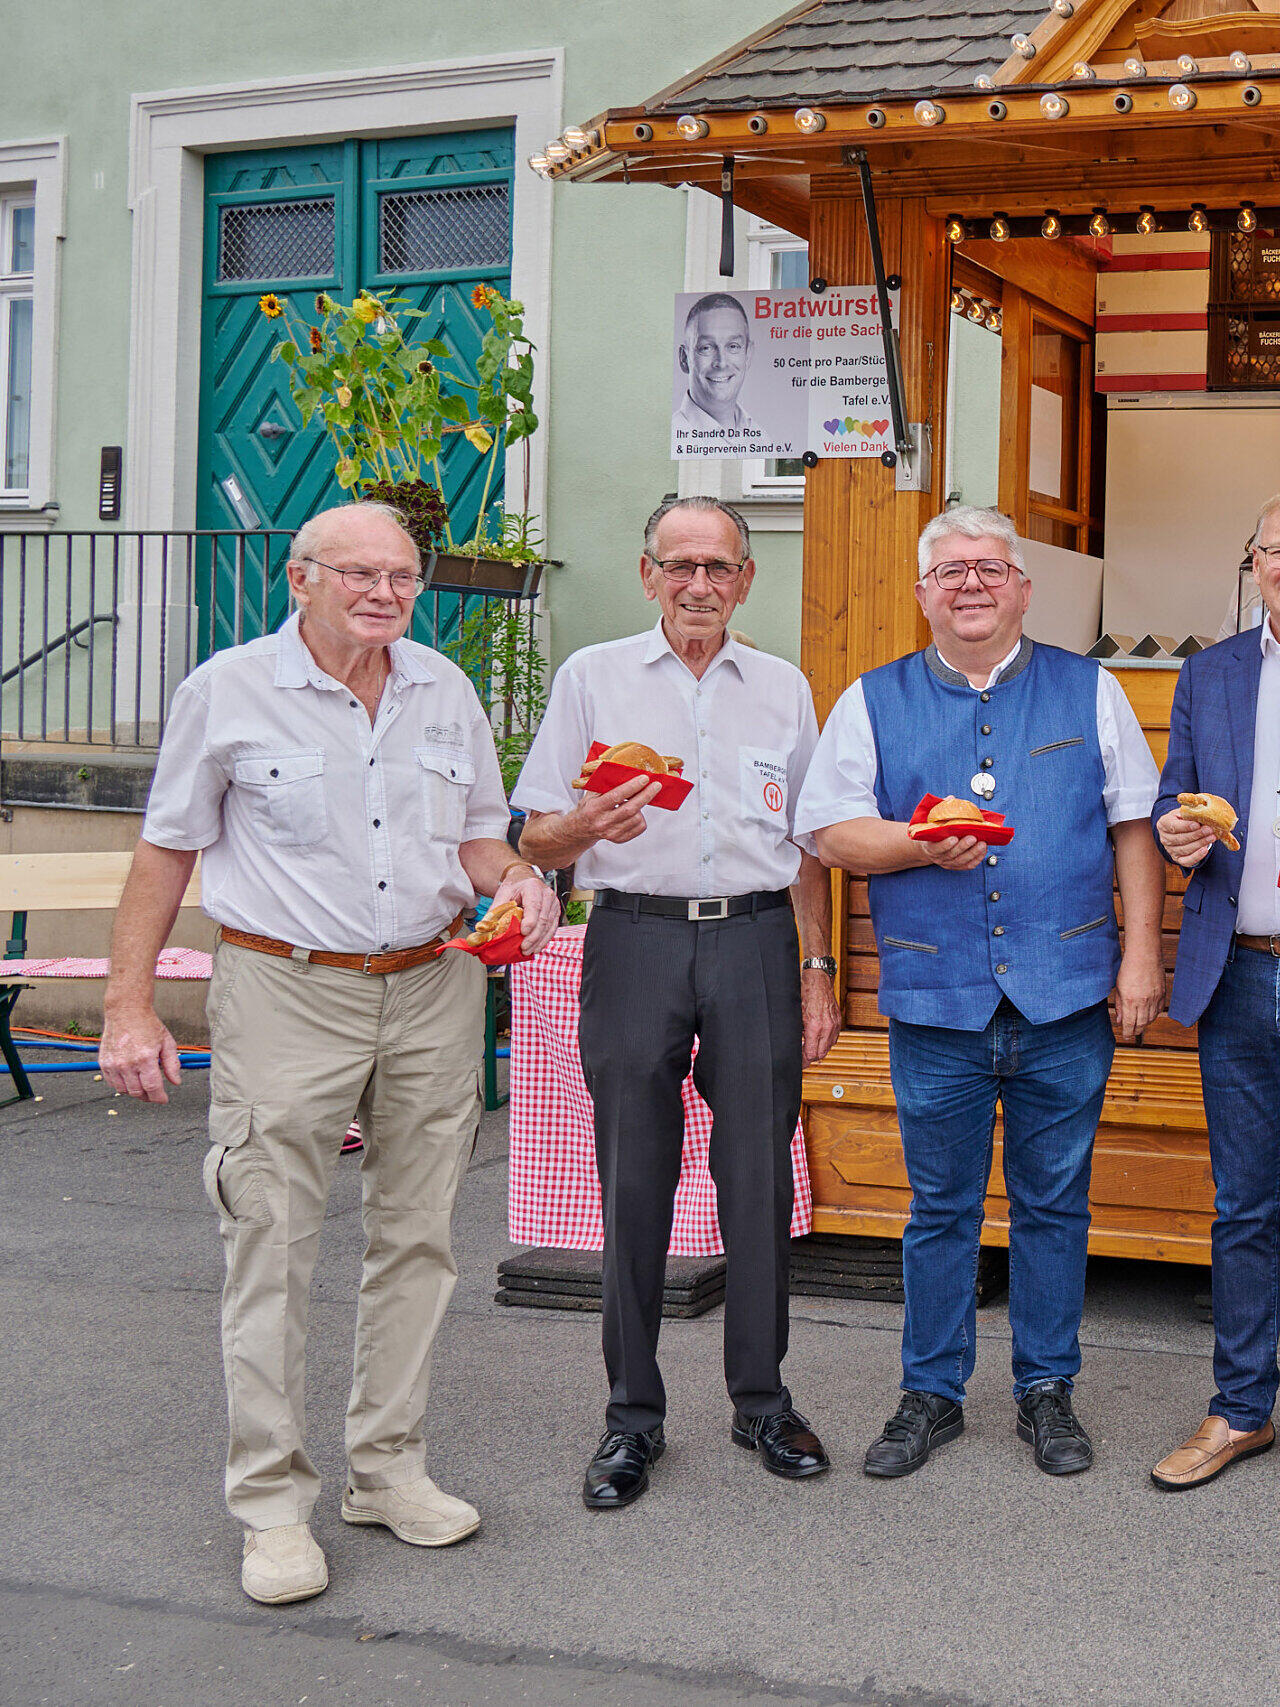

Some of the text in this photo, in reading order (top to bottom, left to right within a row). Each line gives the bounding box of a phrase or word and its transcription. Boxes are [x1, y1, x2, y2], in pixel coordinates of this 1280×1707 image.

[770, 323, 884, 340] für die gute Sach
[773, 355, 886, 369] 50 Cent pro Paar/Stüc
[791, 375, 890, 388] für die Bamberge
[842, 394, 892, 406] Tafel e.V.
[676, 429, 689, 439] Ihr
[728, 428, 741, 438] Da
[743, 428, 762, 438] Ros
[676, 442, 793, 456] & Bürgerverein Sand e.V.
[823, 441, 889, 452] Vielen Dank
